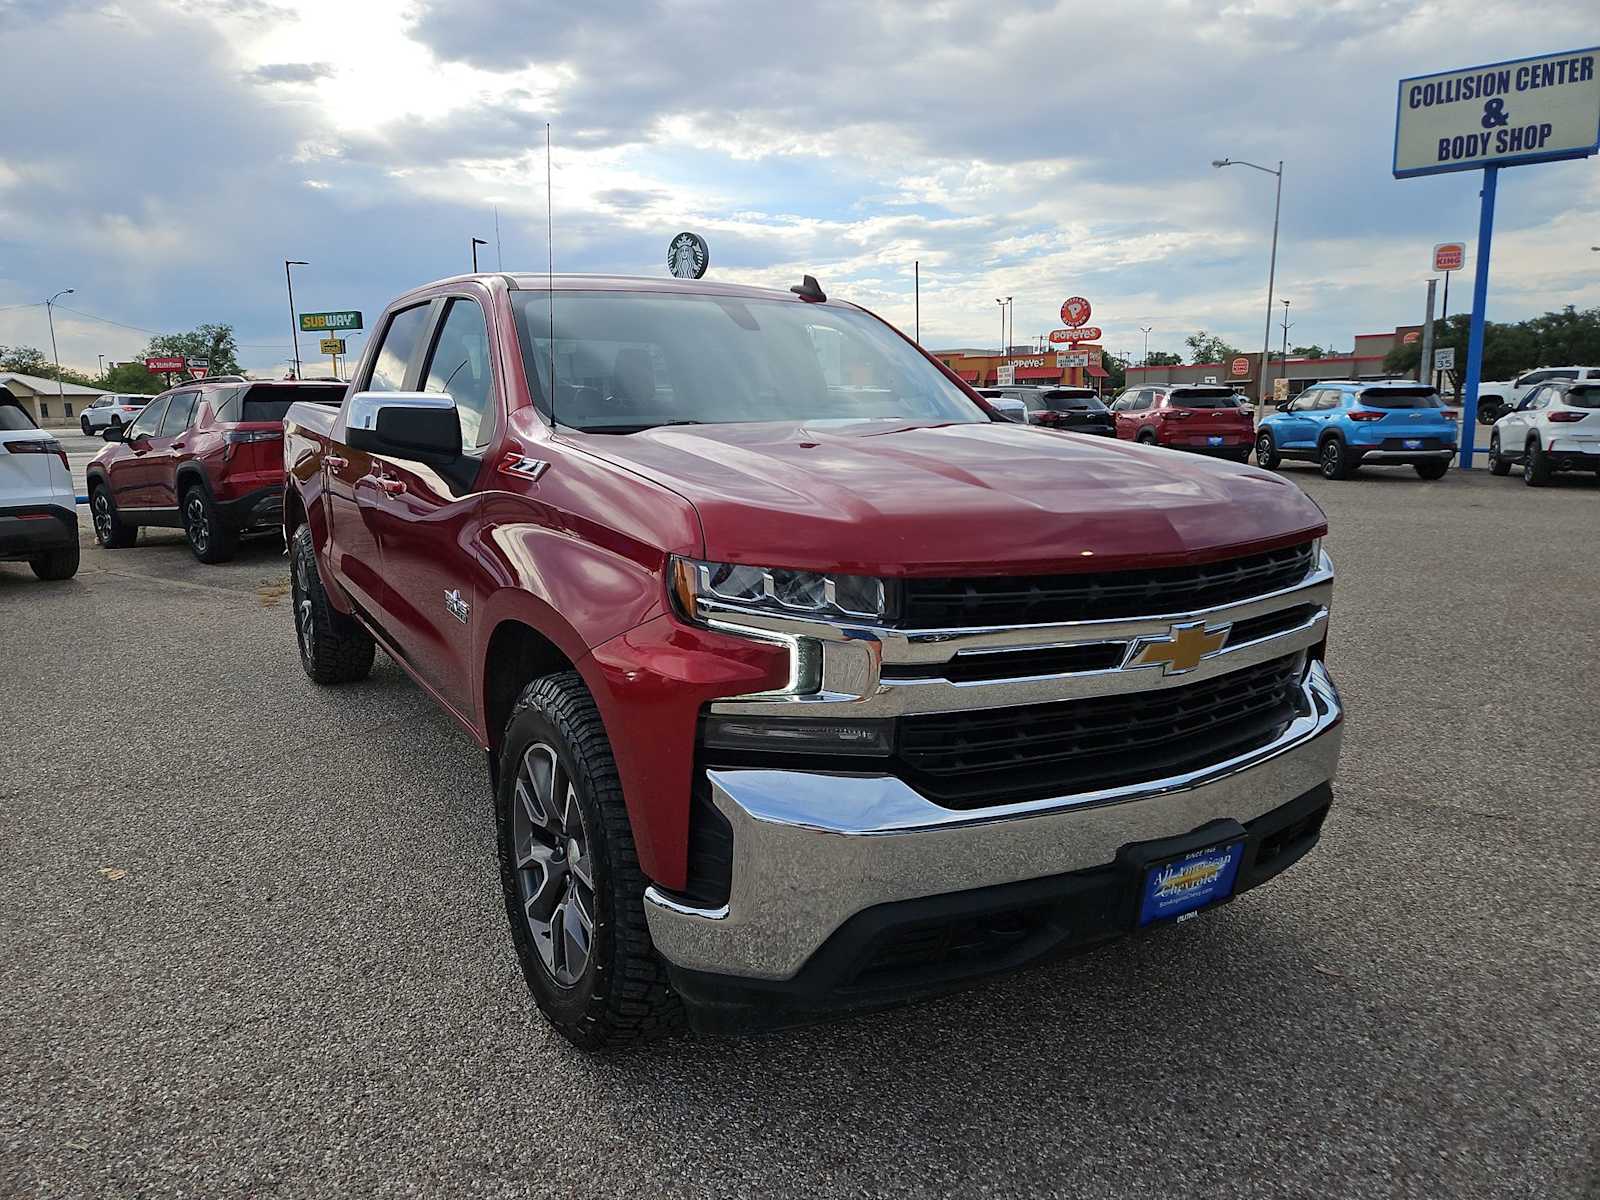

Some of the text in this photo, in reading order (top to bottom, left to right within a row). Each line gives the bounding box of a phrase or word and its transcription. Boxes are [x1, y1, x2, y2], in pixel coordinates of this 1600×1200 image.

[1409, 56, 1594, 109] COLLISION CENTER
[1481, 98, 1509, 128] &
[1438, 123, 1552, 161] BODY SHOP
[1437, 256, 1461, 266] KING
[303, 314, 352, 328] SUBWAY
[1053, 328, 1097, 340] POPEYES
[1437, 360, 1452, 368] 35
[497, 452, 550, 481] Z71
